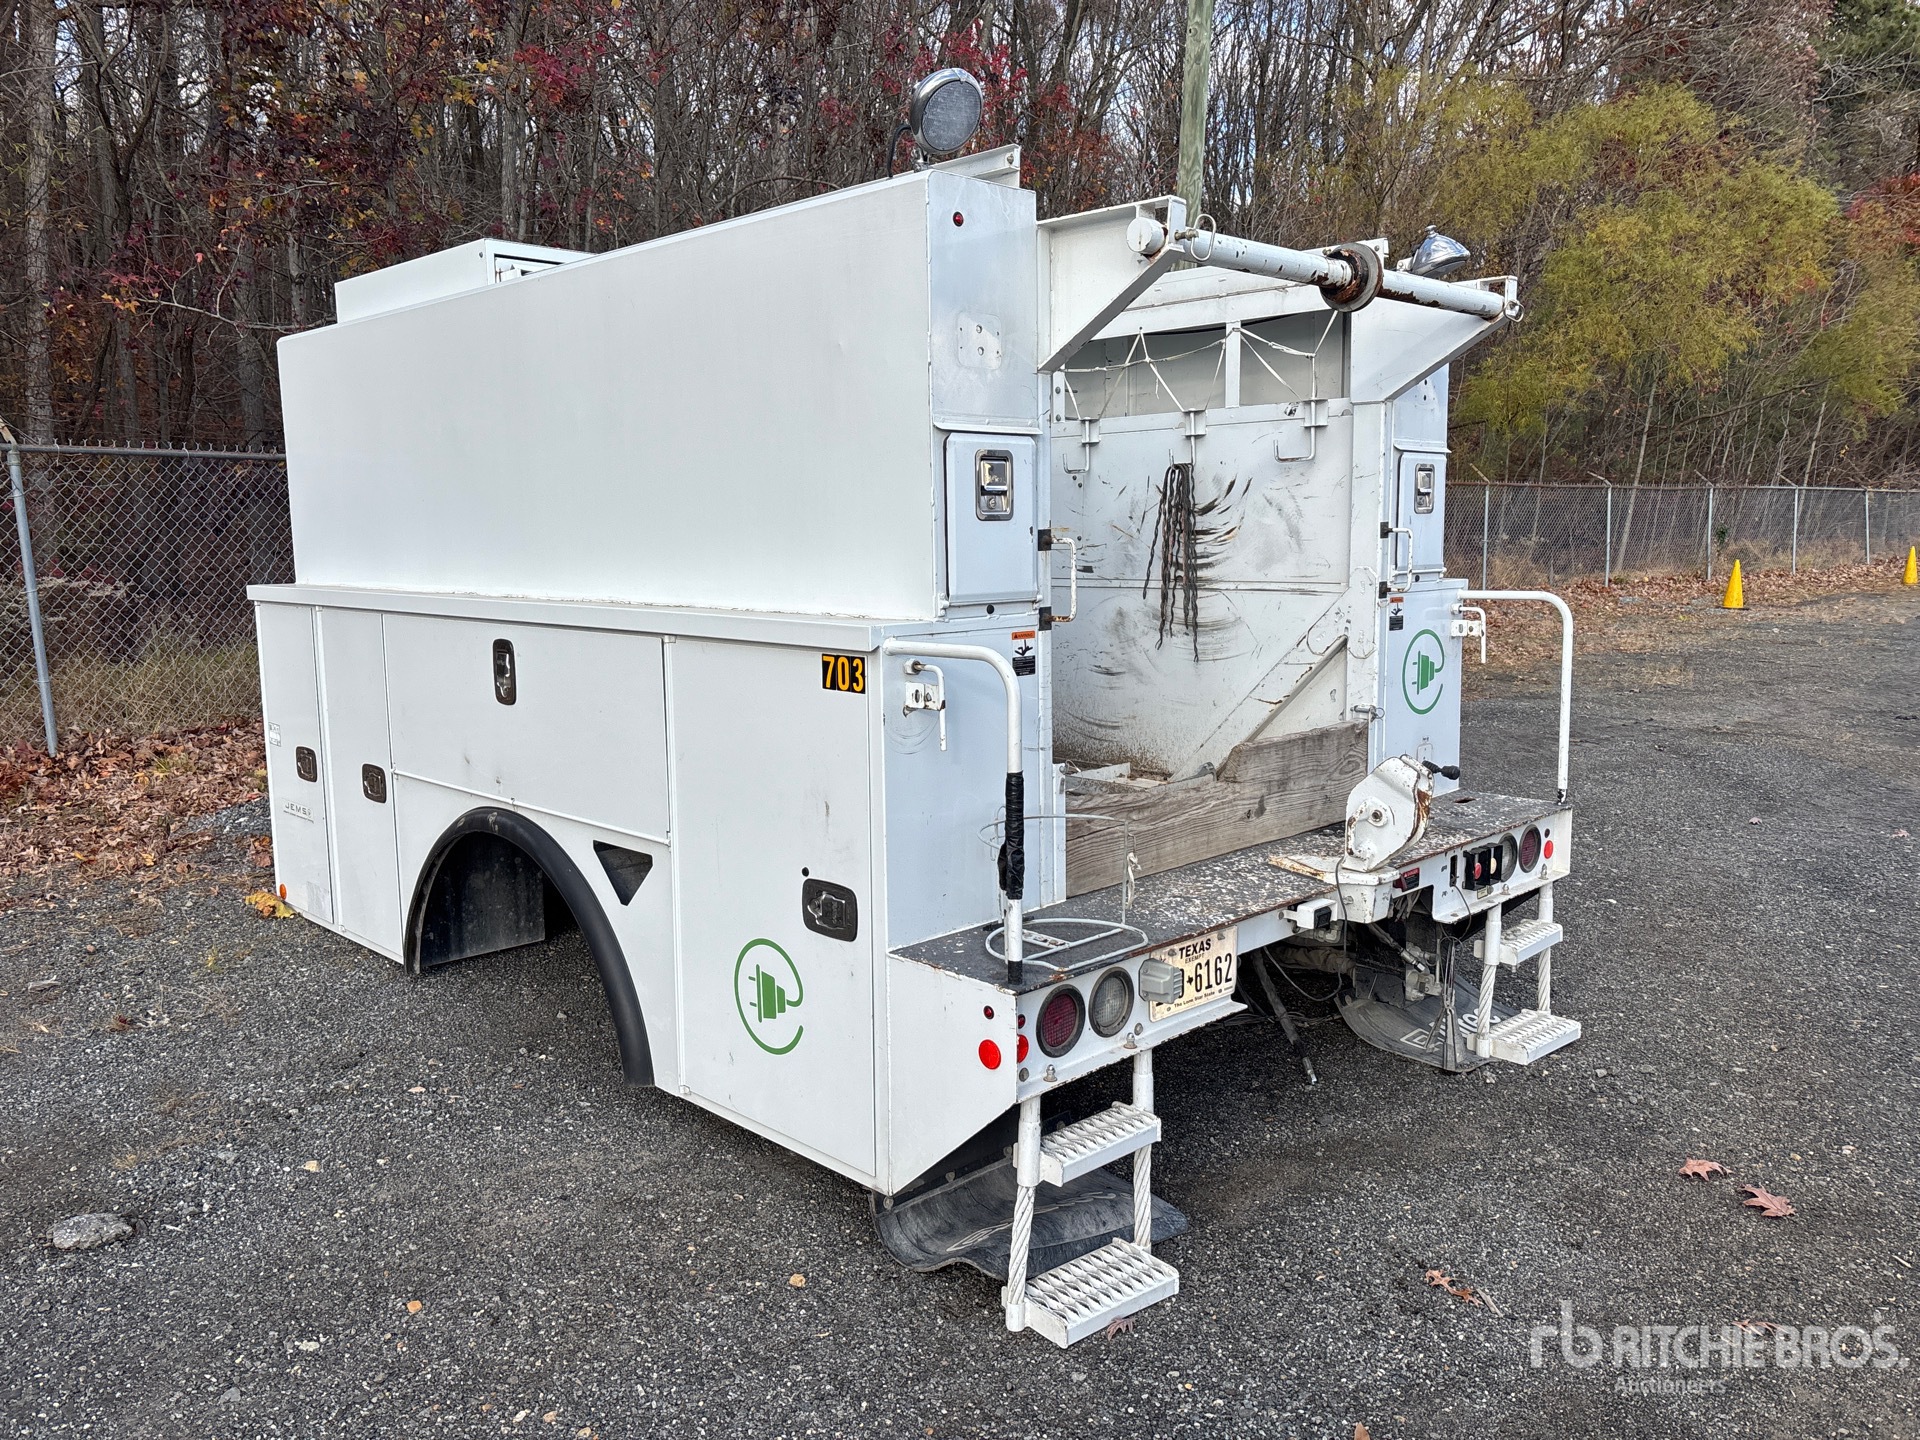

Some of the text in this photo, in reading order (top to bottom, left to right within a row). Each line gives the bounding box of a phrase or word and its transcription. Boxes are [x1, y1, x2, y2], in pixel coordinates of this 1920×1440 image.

[822, 655, 864, 692] 703
[1179, 938, 1211, 959] TEXAS
[1185, 953, 1205, 964] EXEMPT
[1195, 953, 1232, 993] 6162
[1204, 990, 1216, 998] State
